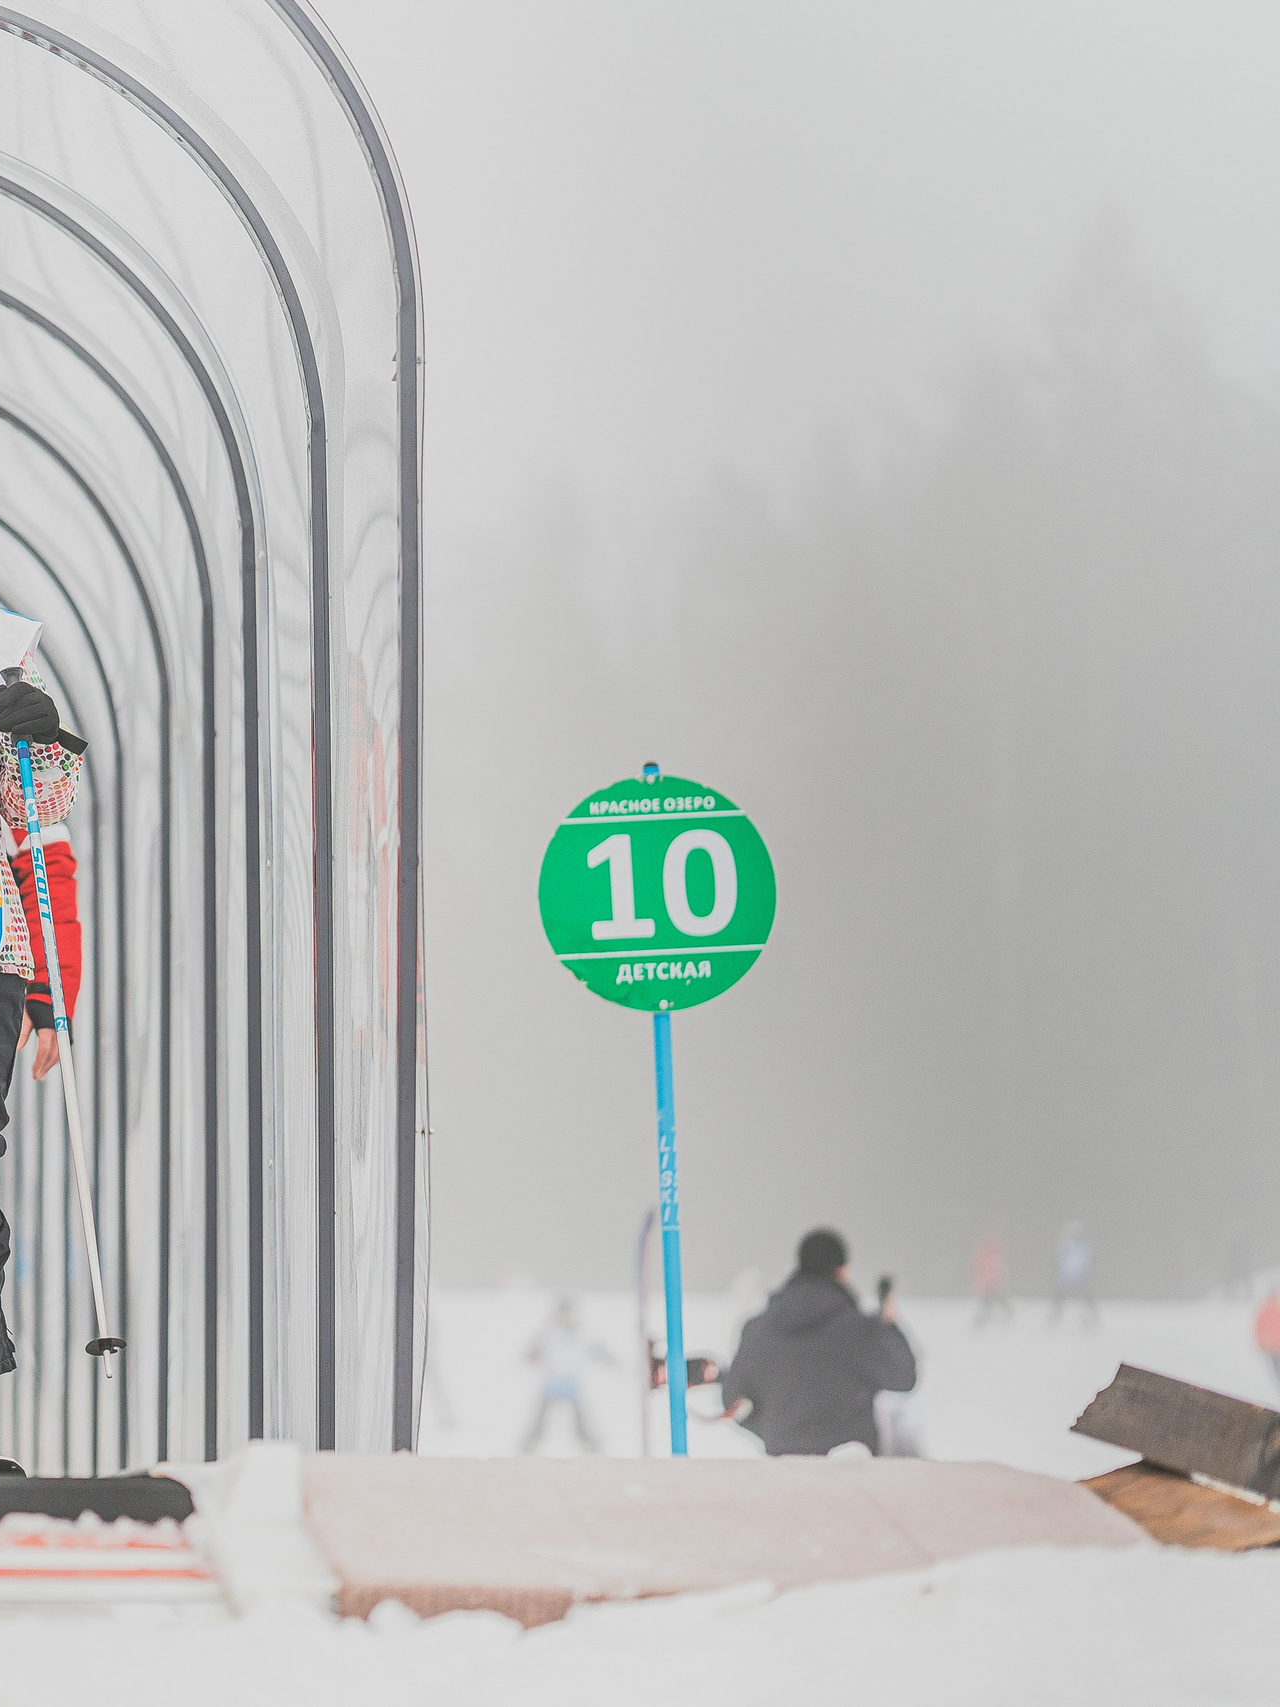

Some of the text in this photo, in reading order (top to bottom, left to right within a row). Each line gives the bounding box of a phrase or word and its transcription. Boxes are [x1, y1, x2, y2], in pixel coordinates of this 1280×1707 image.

[589, 795, 716, 815] КРАСНОЕ ОЗЕРО
[31, 846, 52, 924] SCOTT
[586, 829, 738, 941] 10
[616, 960, 711, 985] ДЕТСКАЯ
